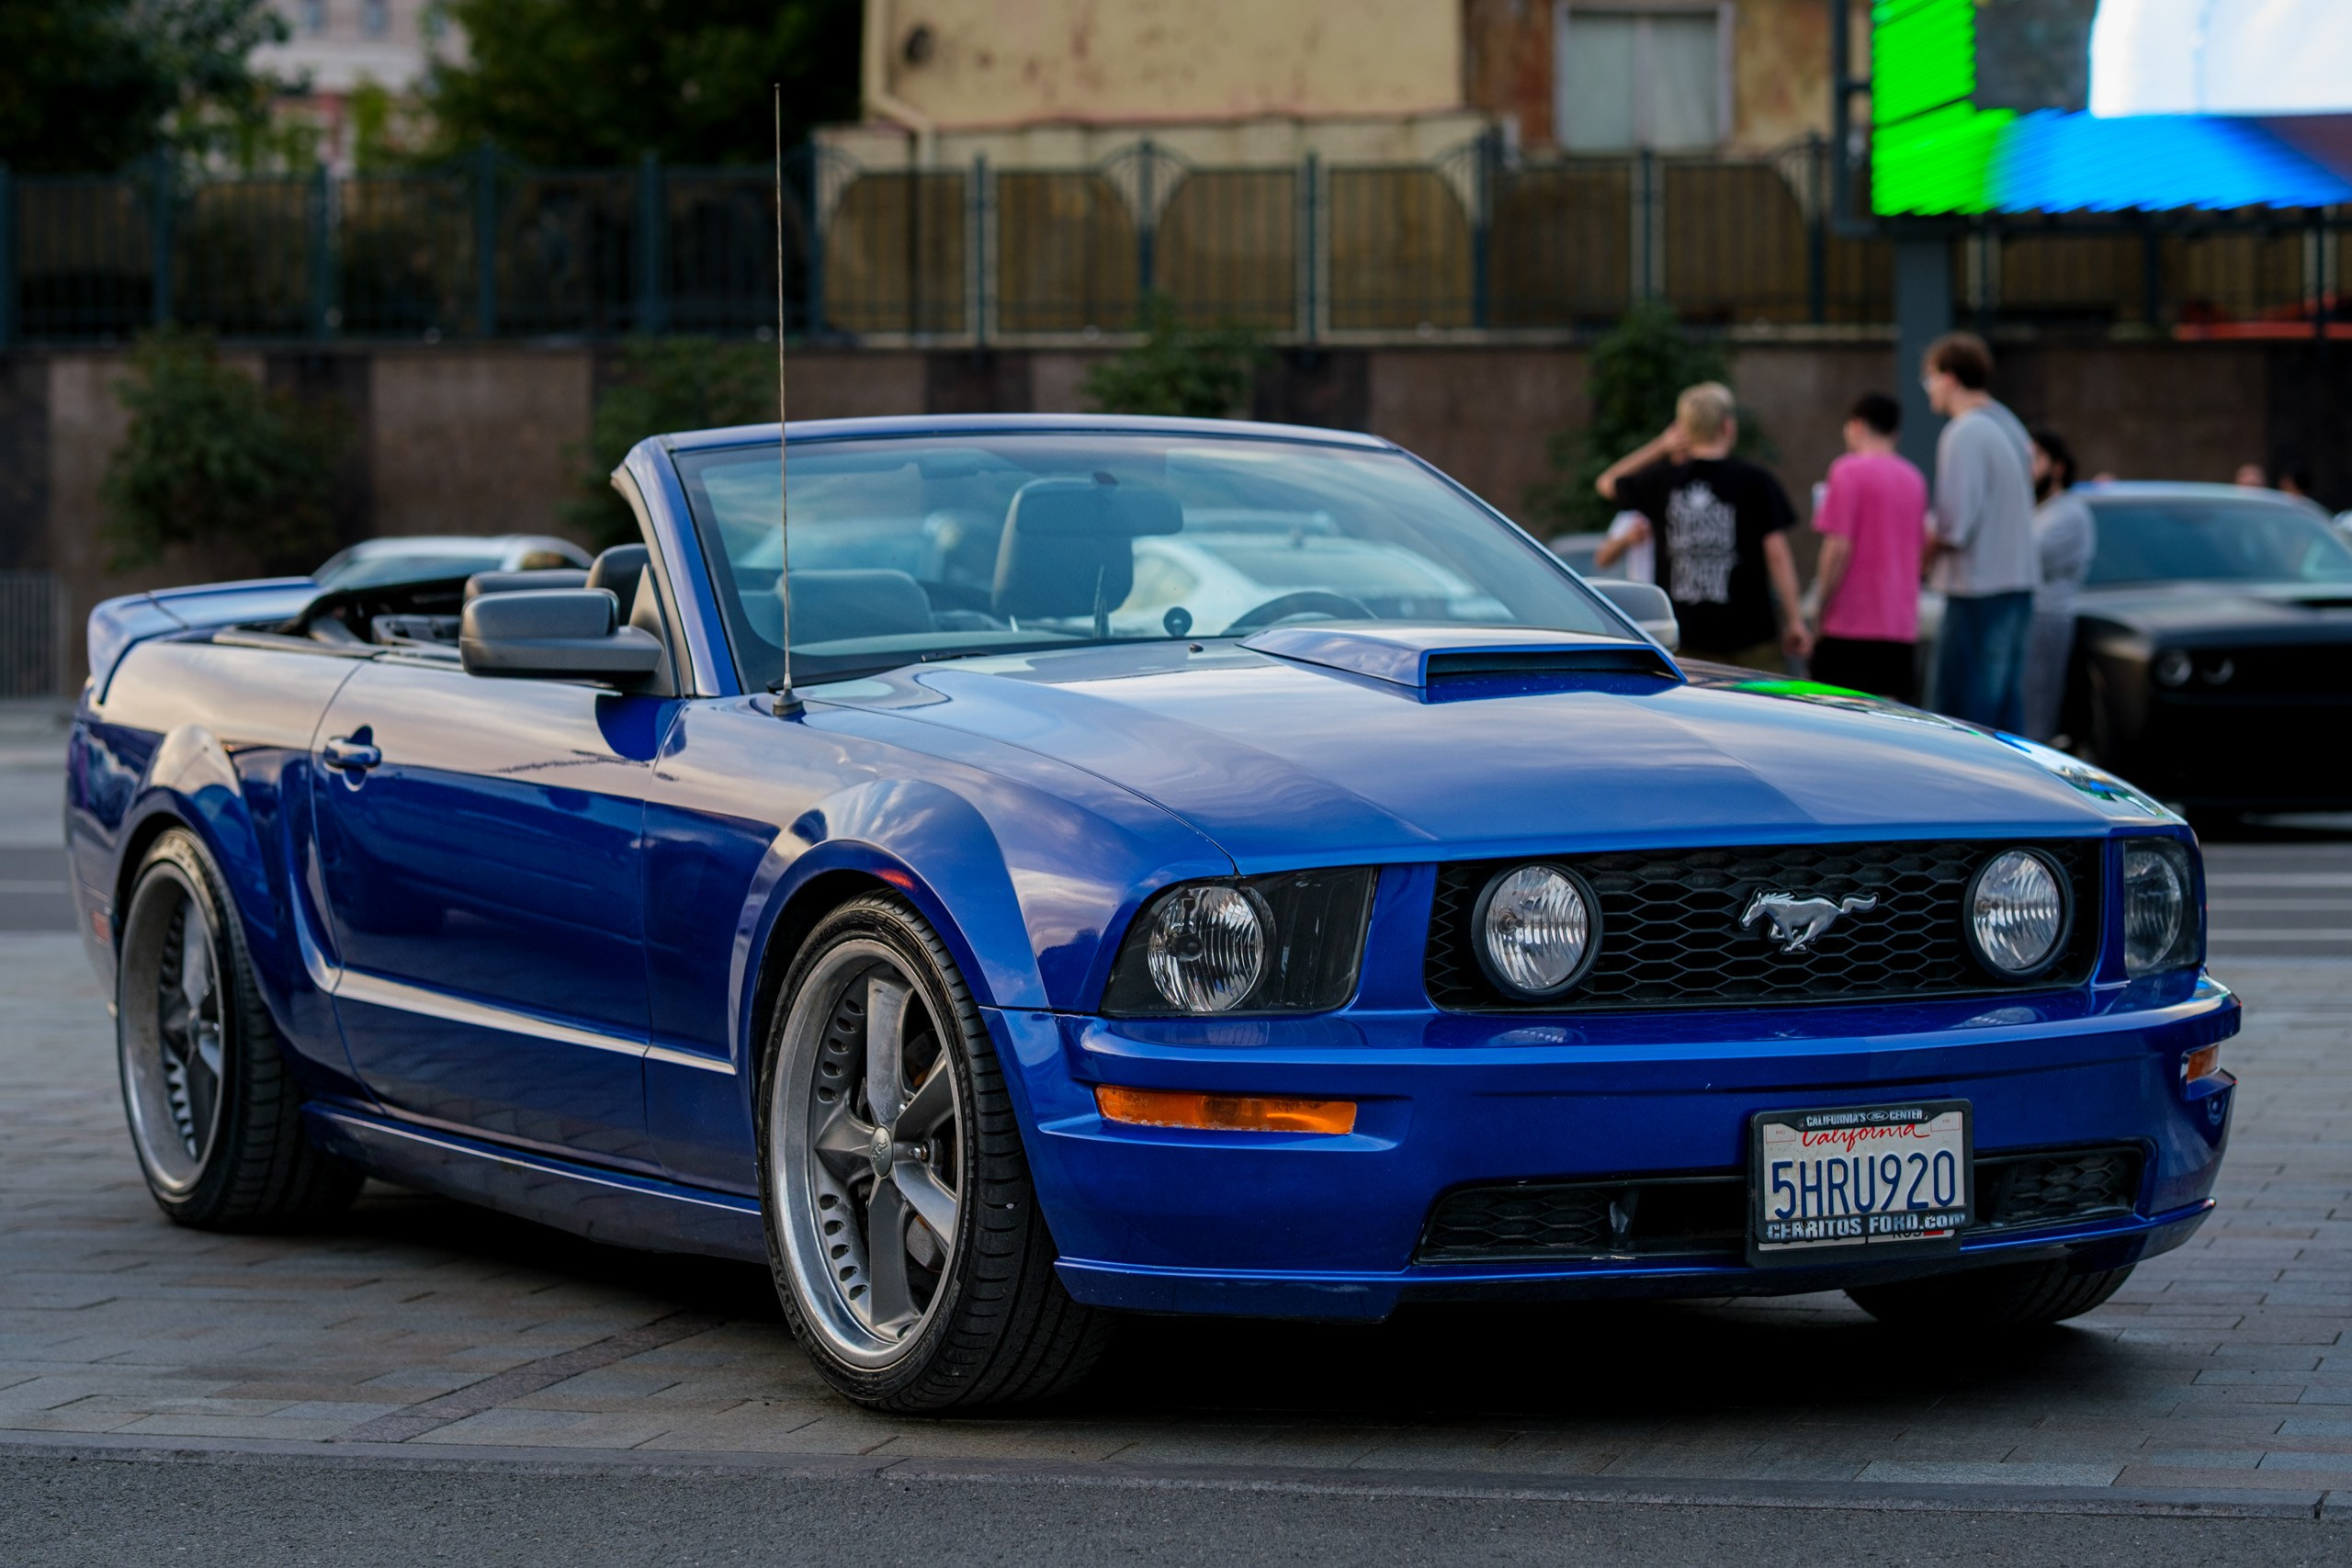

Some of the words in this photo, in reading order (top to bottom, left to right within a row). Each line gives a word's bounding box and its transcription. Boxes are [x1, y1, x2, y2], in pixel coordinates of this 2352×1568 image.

[1806, 1111, 1866, 1126] CALIFORNIA'S
[1889, 1110, 1923, 1121] CENTER
[1802, 1122, 1930, 1153] California
[1772, 1150, 1956, 1220] 5HRU920
[1767, 1217, 1861, 1240] CERRITOS
